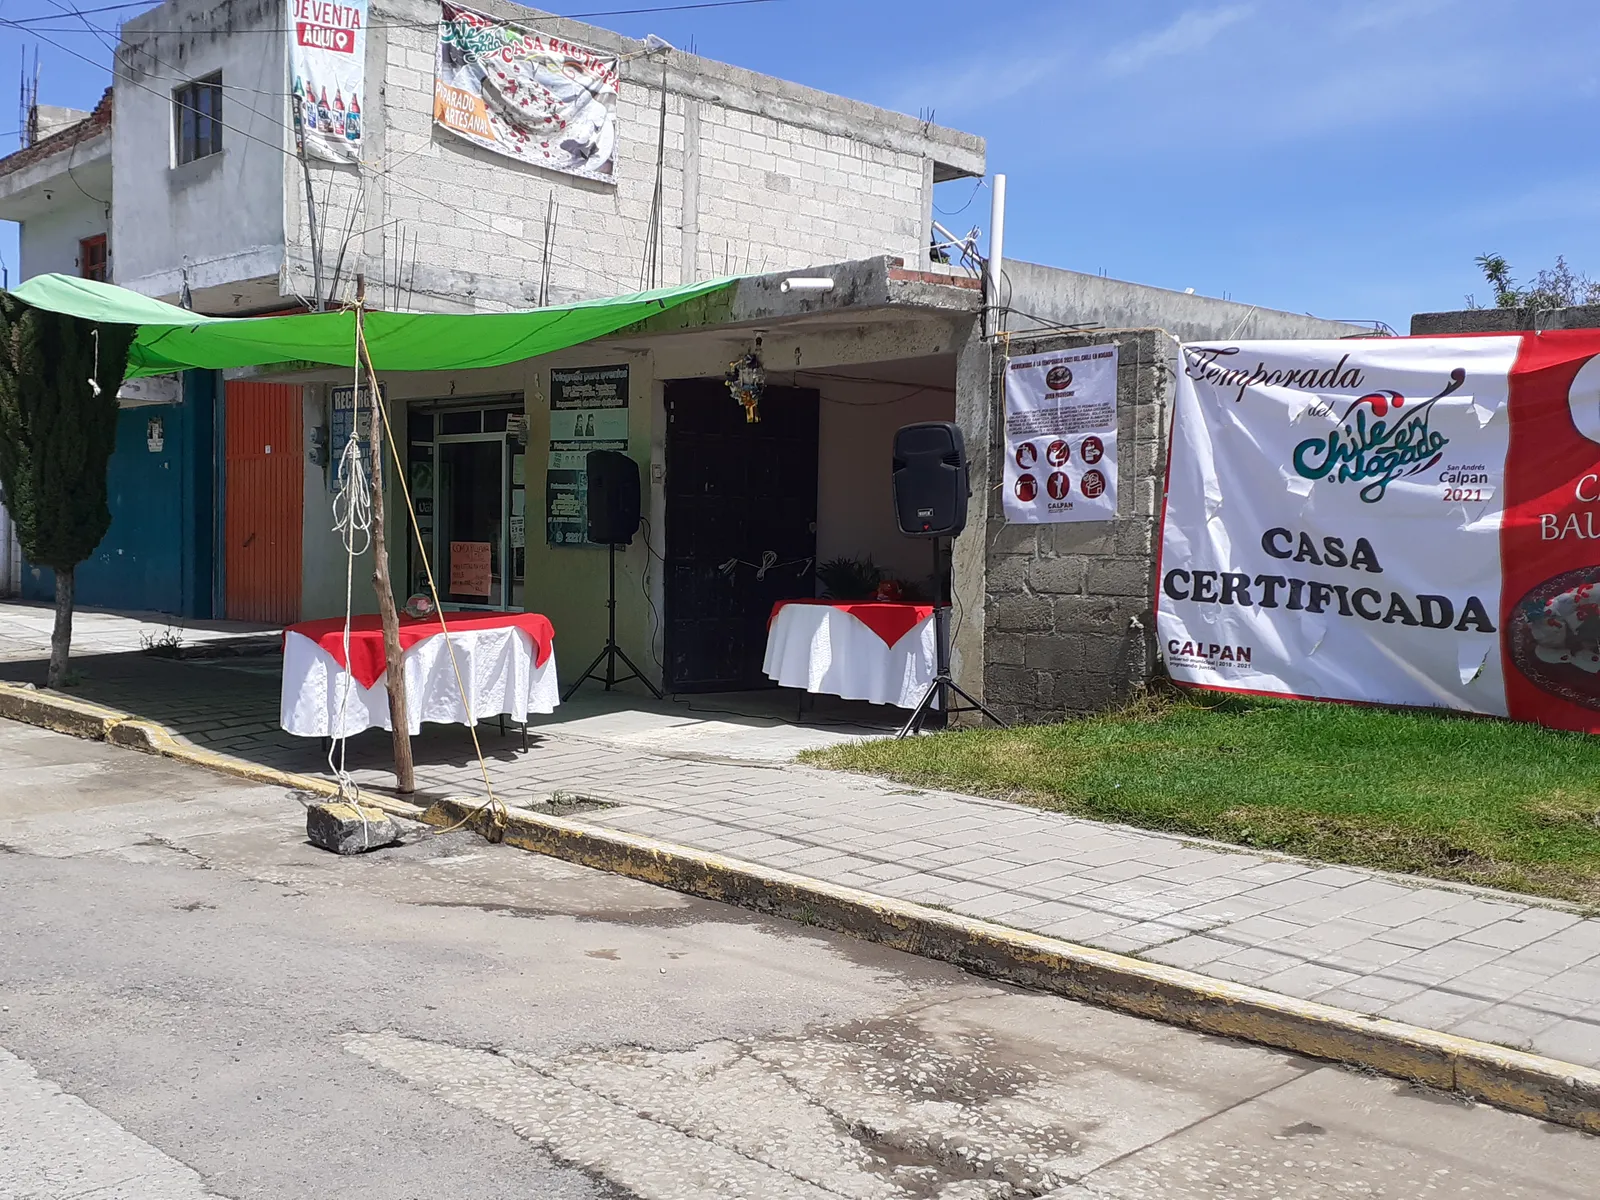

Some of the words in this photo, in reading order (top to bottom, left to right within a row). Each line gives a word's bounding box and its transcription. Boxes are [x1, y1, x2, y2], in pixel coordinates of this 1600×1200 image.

[312, 0, 361, 29] VENTA
[501, 36, 545, 63] CASA
[445, 106, 489, 135] ARTESANAL
[1184, 346, 1365, 402] Temporada
[1308, 400, 1334, 419] del
[1293, 409, 1393, 481] Chile
[1391, 419, 1429, 449] en
[1337, 432, 1450, 504] Nogada
[1439, 471, 1488, 486] Calpan
[1461, 463, 1485, 471] Andrés
[1443, 488, 1482, 502] 2021
[1575, 474, 1600, 502] C
[1047, 501, 1074, 509] CALPAN
[1261, 527, 1384, 573] CASA
[1163, 568, 1497, 633] CERTIFICADA
[1168, 640, 1251, 662] CALPAN
